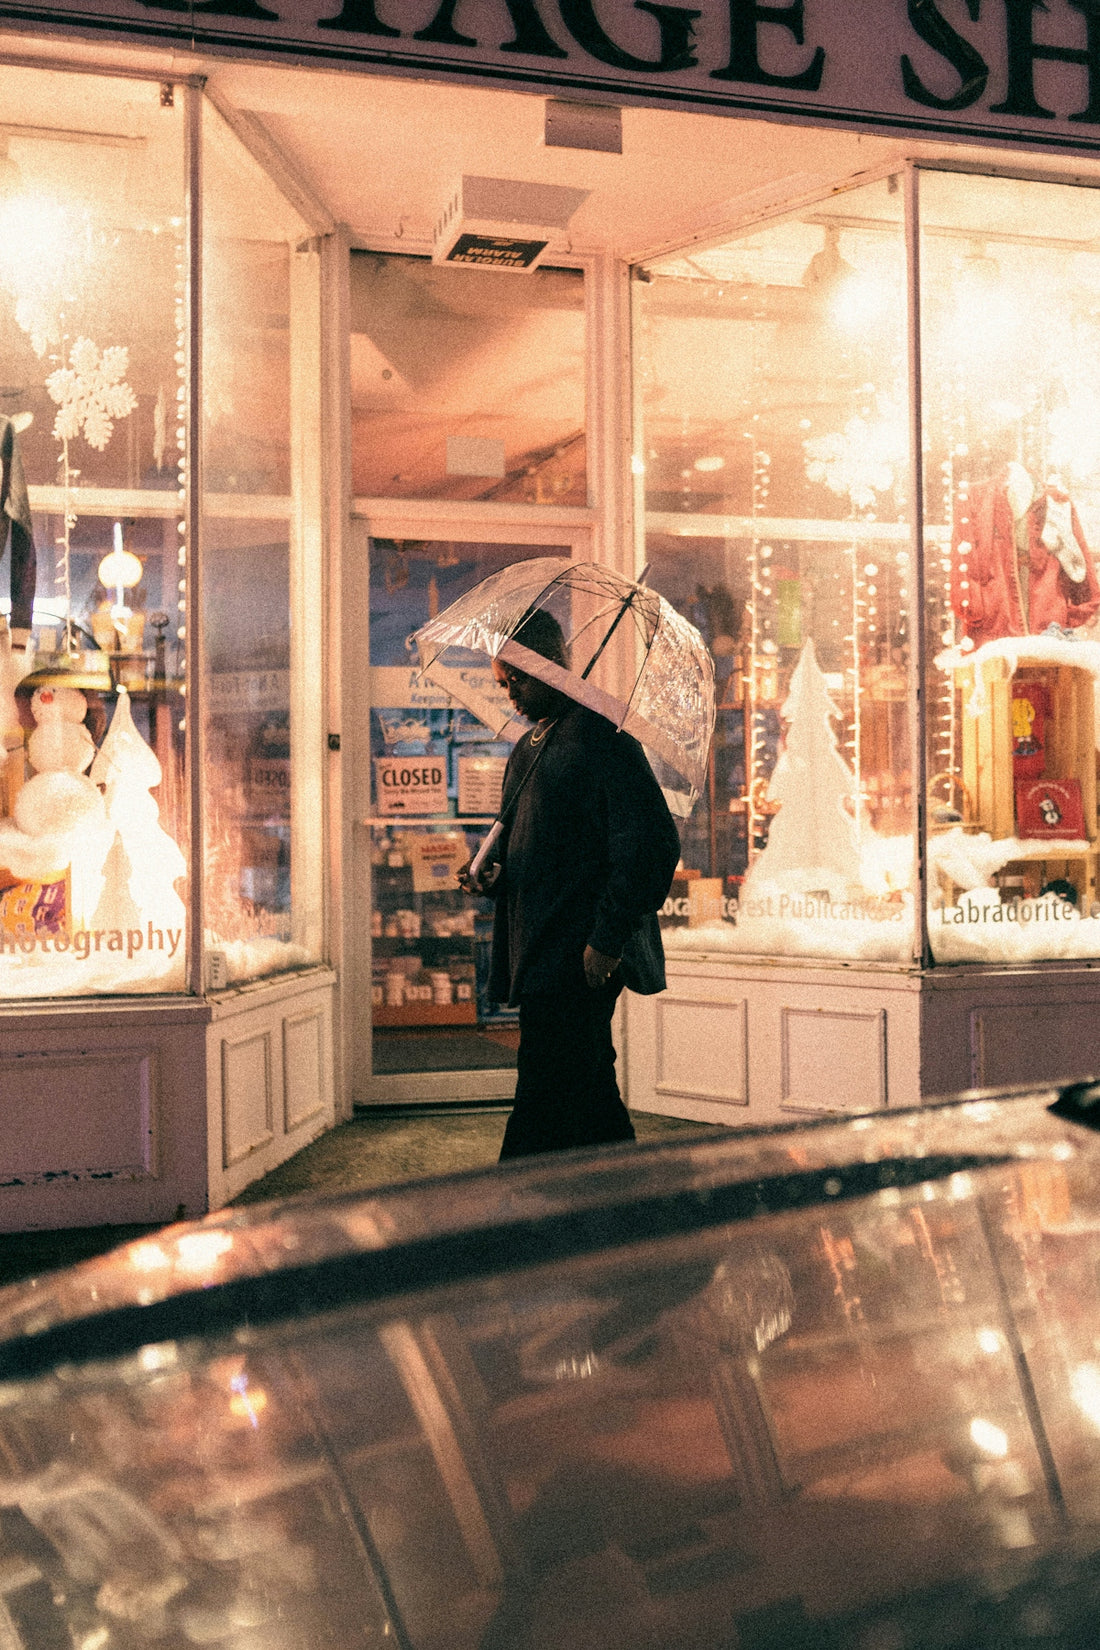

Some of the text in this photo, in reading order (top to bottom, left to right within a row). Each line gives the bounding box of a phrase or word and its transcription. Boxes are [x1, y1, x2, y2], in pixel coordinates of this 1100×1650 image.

[467, 247, 523, 258] ALARM
[382, 767, 442, 787] CLOSED
[656, 892, 698, 917] ocal
[941, 896, 1073, 924] Labradorite
